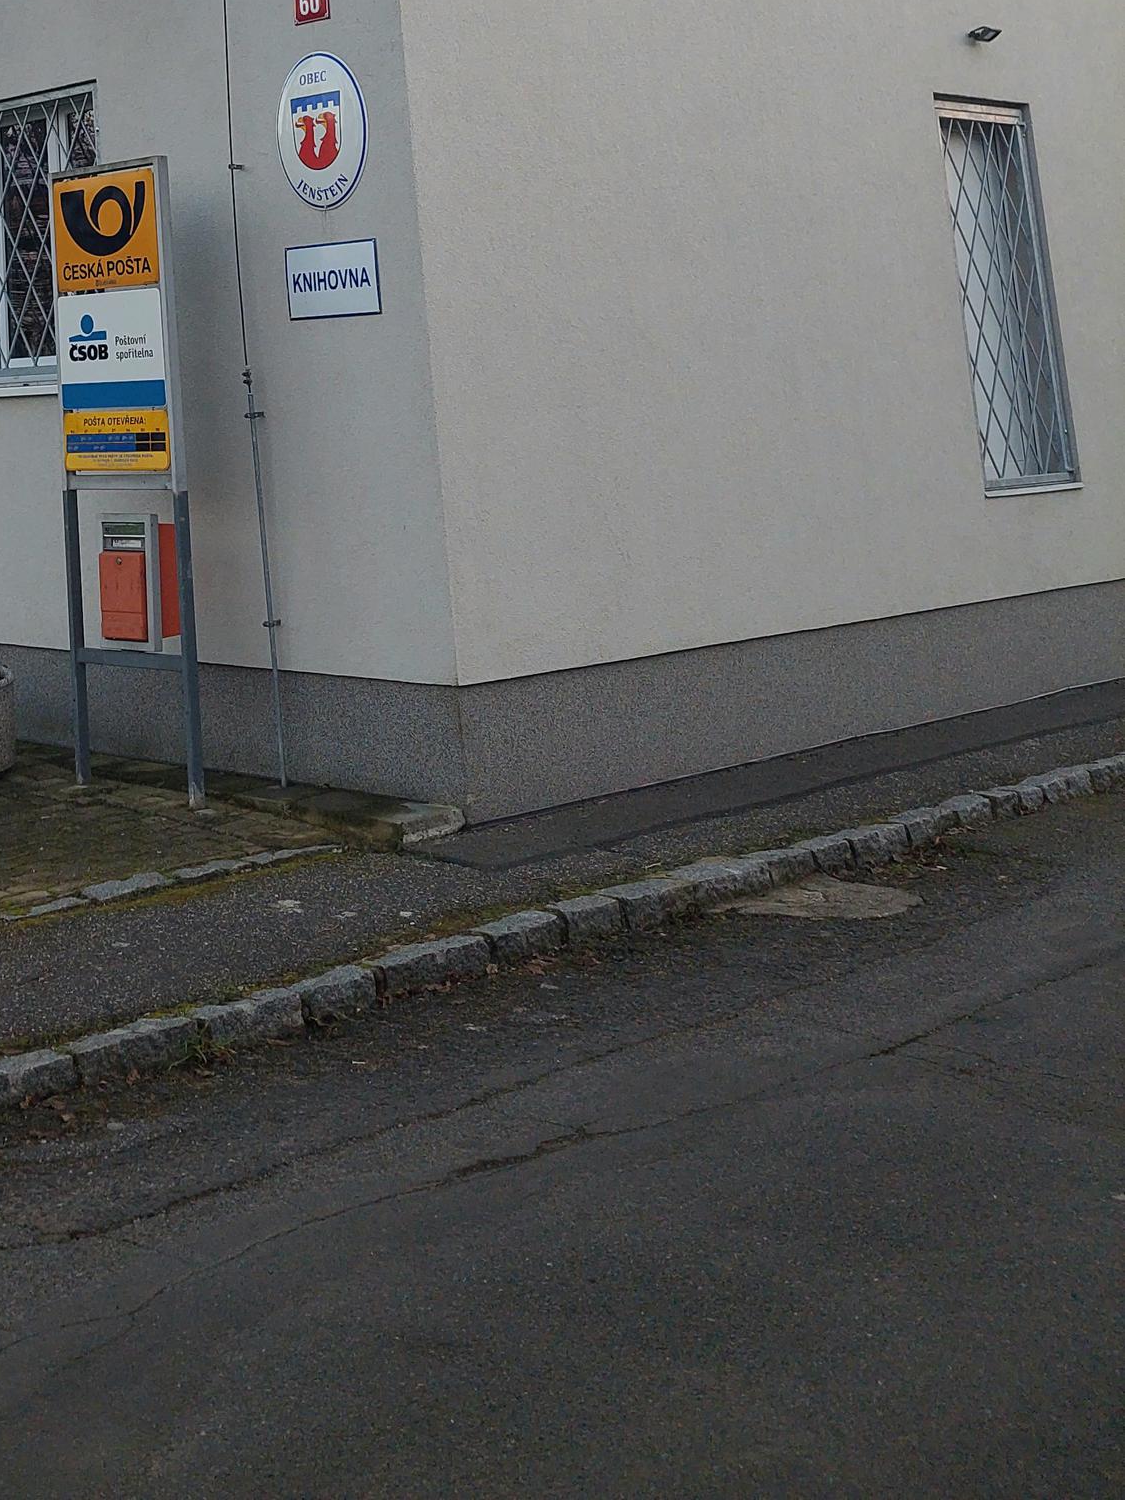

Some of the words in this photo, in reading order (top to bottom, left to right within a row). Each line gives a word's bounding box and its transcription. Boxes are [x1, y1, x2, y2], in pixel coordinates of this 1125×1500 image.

[299, 70, 327, 86] OBEC
[296, 173, 349, 202] JENŠTEJN
[63, 260, 104, 281] ČESKÁ
[106, 256, 151, 277] POŠTA
[292, 266, 372, 294] KNIHOVNA
[115, 334, 147, 347] Poštovní
[69, 344, 109, 362] ČSOB
[115, 347, 154, 362] spořitelna
[83, 416, 106, 427] POŠTA
[107, 415, 147, 426] OTEVŘENA:
